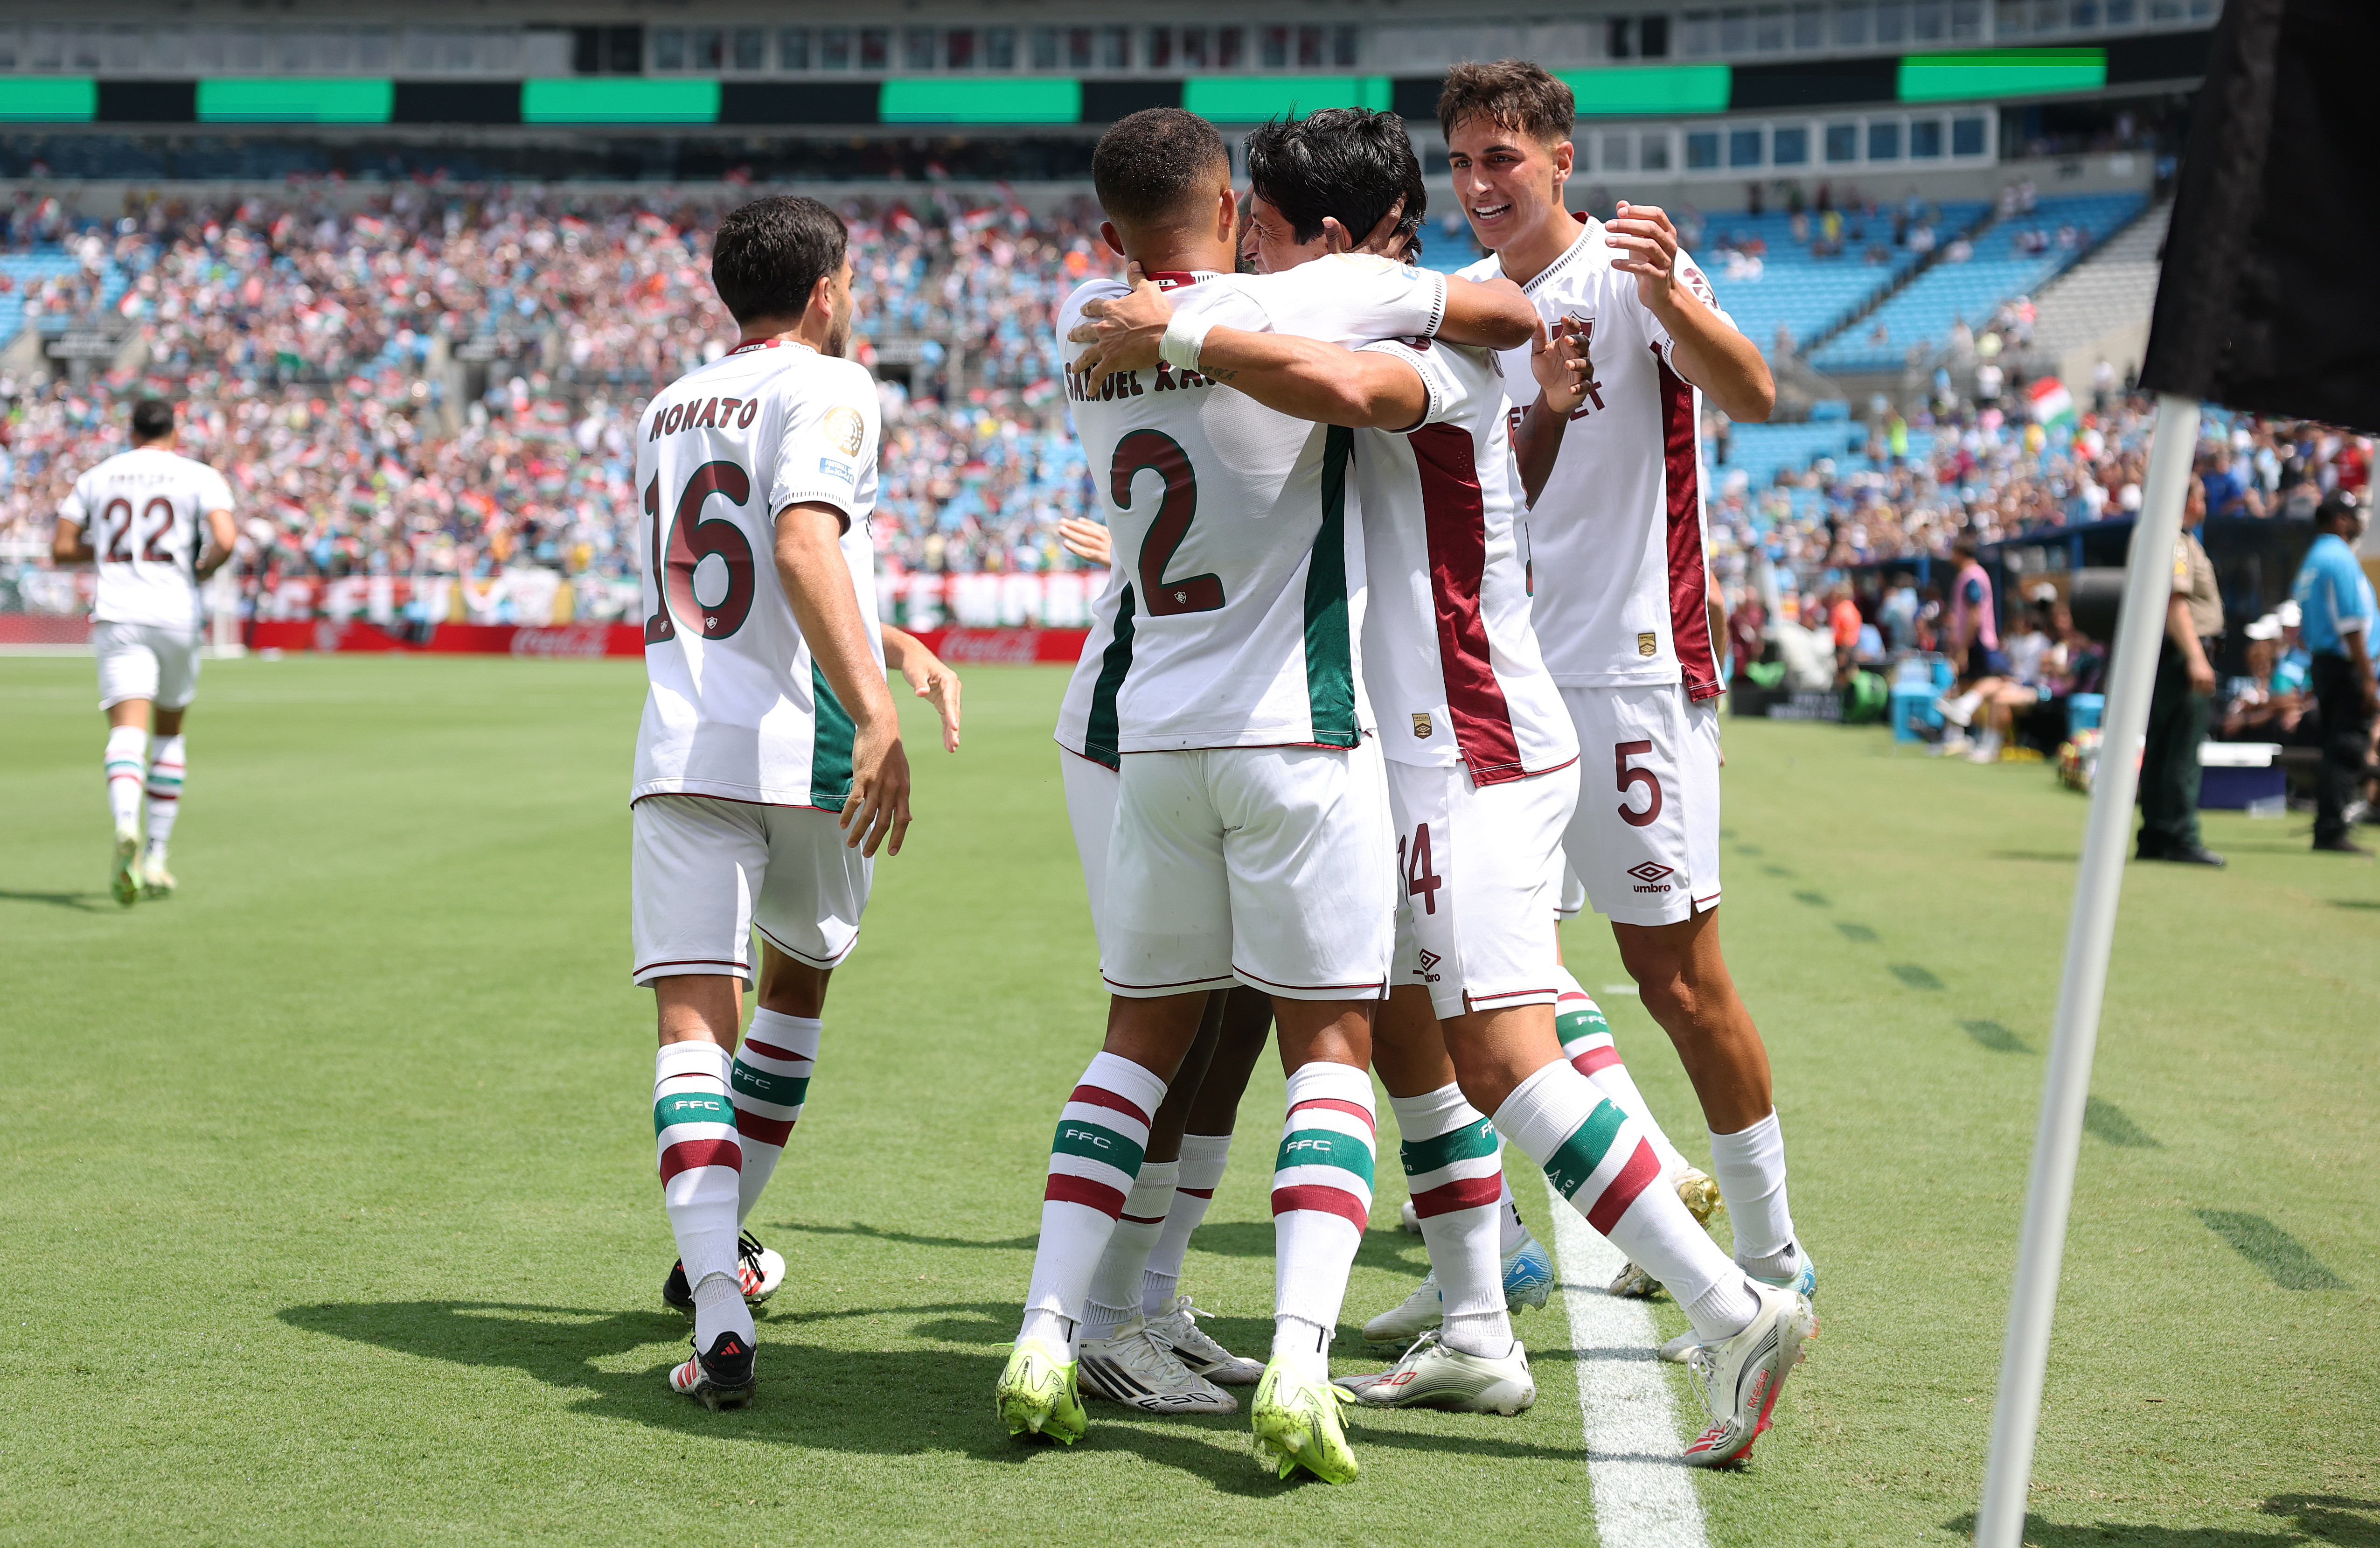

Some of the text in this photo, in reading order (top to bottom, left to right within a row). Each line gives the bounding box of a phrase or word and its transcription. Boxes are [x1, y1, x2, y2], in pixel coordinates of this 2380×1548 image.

[1154, 361, 1216, 391] XA
[649, 397, 758, 442] NONATO
[825, 459, 848, 473] FOOTBALL
[104, 498, 174, 562] 22
[1110, 429, 1225, 617] 2
[645, 460, 755, 645] 16
[1615, 740, 1662, 826] 5
[1398, 823, 1441, 915] 14
[1633, 883, 1671, 893] umbro
[1576, 1015, 1607, 1025] FFC
[734, 1067, 771, 1090] FFC
[675, 1101, 720, 1111] FFC
[1065, 1129, 1111, 1150] FFC
[1481, 1120, 1494, 1139] FF
[1286, 1139, 1332, 1154] FFC
[1353, 1372, 1418, 1388] F50
[1748, 1368, 1771, 1408] MESSI
[1138, 1393, 1219, 1410] F50
